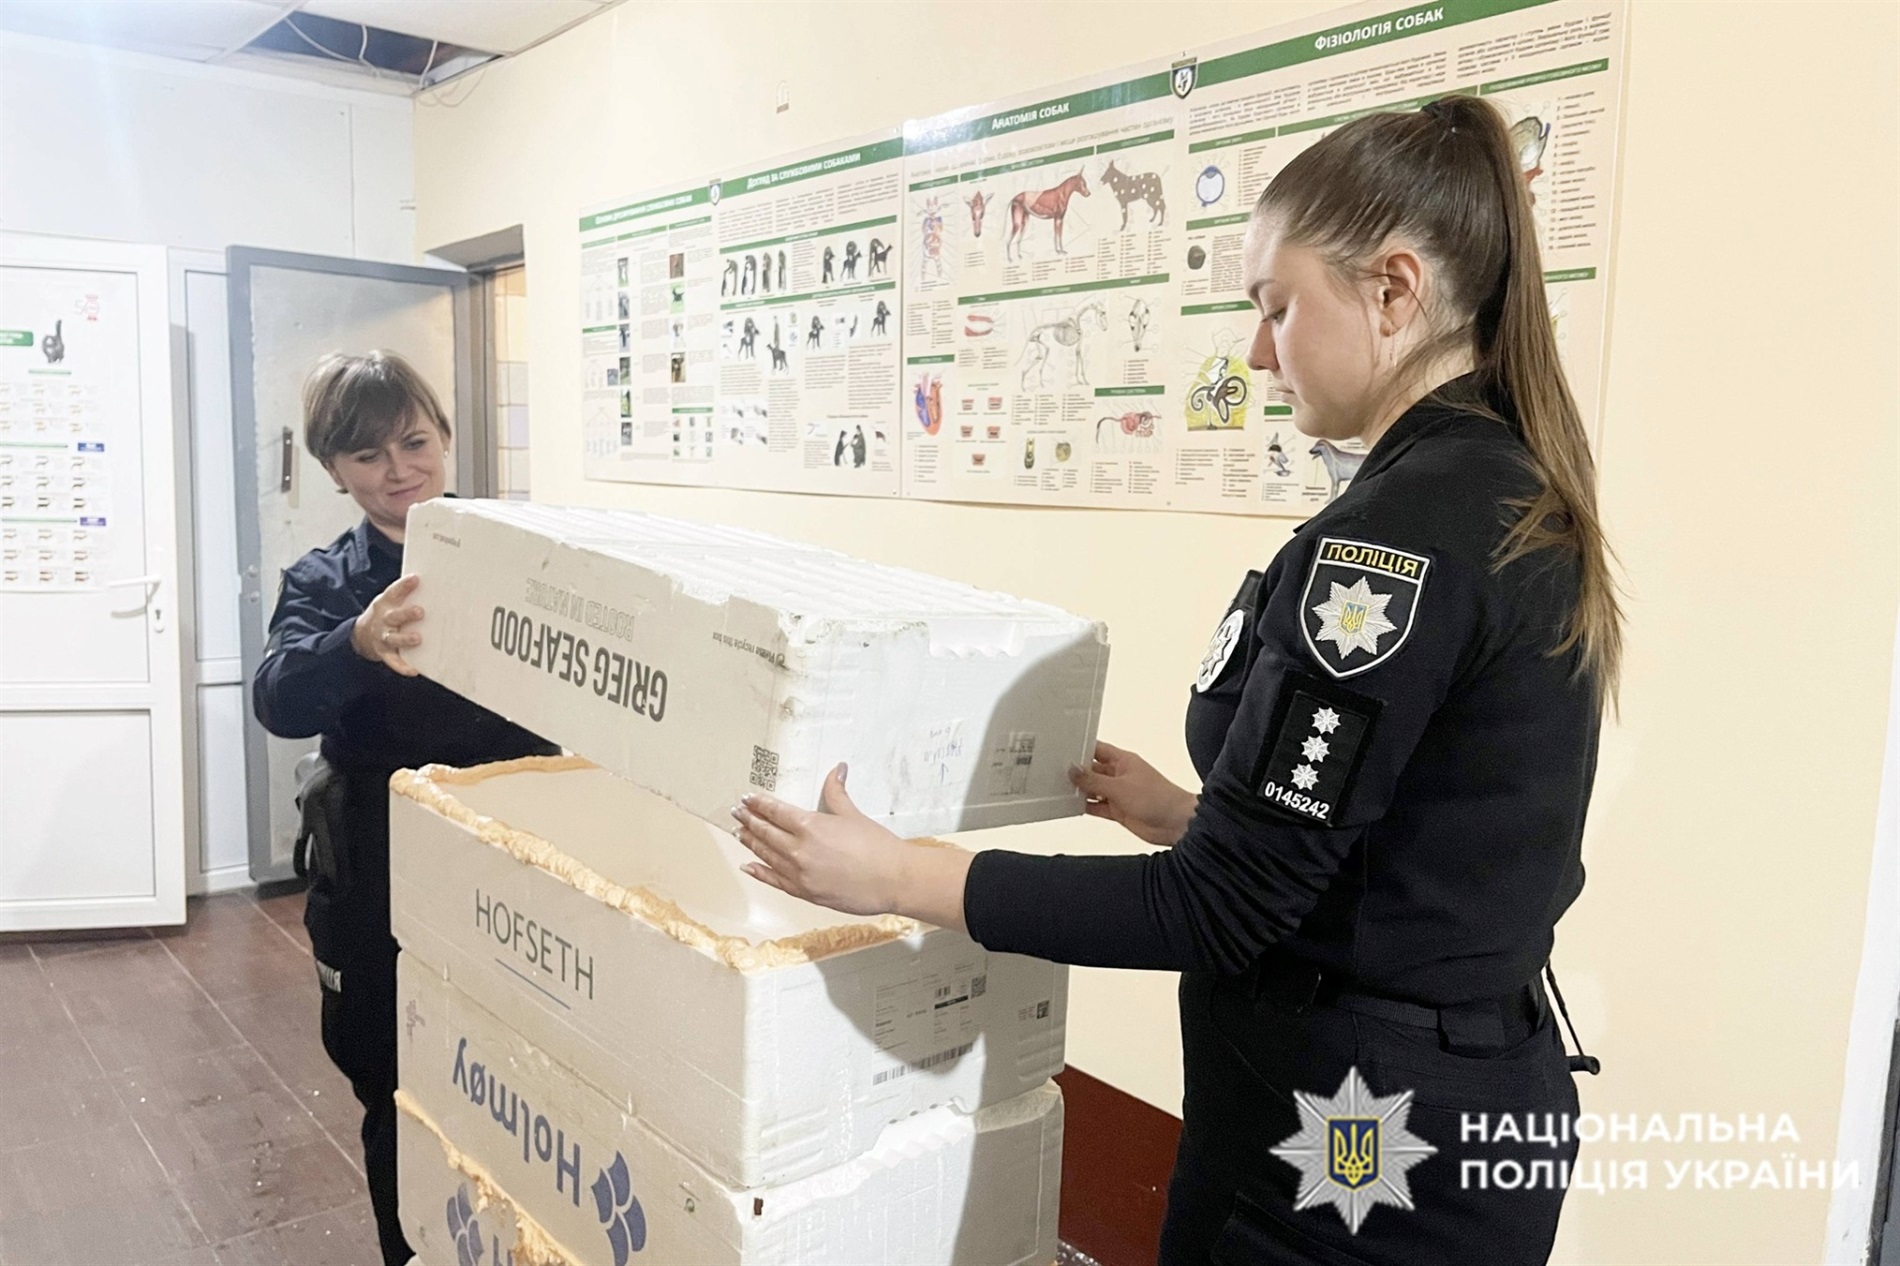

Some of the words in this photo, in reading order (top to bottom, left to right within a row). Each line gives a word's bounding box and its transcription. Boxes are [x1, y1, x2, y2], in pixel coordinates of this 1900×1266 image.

[1314, 21, 1392, 50] ФІЗІОЛОГІЯ
[1395, 7, 1444, 31] СОБАК
[1039, 102, 1070, 119] СОБАК
[1326, 543, 1419, 577] ПОЛІЦІЯ
[585, 600, 636, 643] ROOTED
[490, 605, 590, 688] SEAFOOD
[755, 646, 776, 664] Please
[593, 646, 668, 722] GRIEG
[1264, 781, 1331, 820] 0145242
[475, 888, 594, 1000] HOFSETH
[452, 1037, 581, 1208] Holmøy
